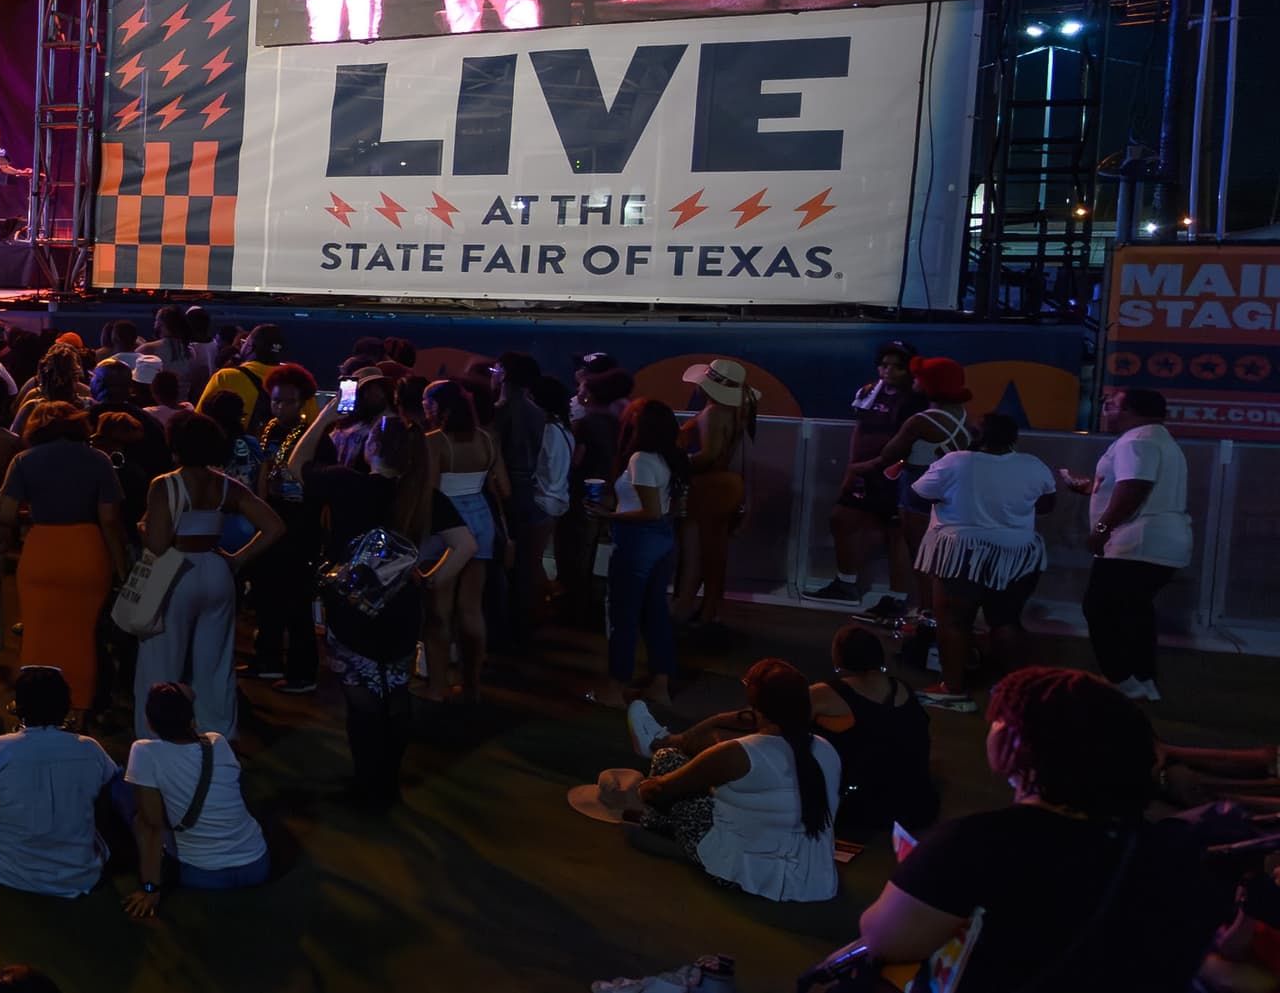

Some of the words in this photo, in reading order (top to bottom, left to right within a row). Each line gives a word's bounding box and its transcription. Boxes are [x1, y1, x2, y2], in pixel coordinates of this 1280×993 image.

[326, 36, 852, 177] LIVE
[482, 195, 542, 226] AT
[554, 194, 646, 226] THE
[320, 242, 445, 273] STATE
[460, 243, 564, 275] FAIR
[582, 244, 652, 276] OF
[1118, 299, 1280, 330] STAG
